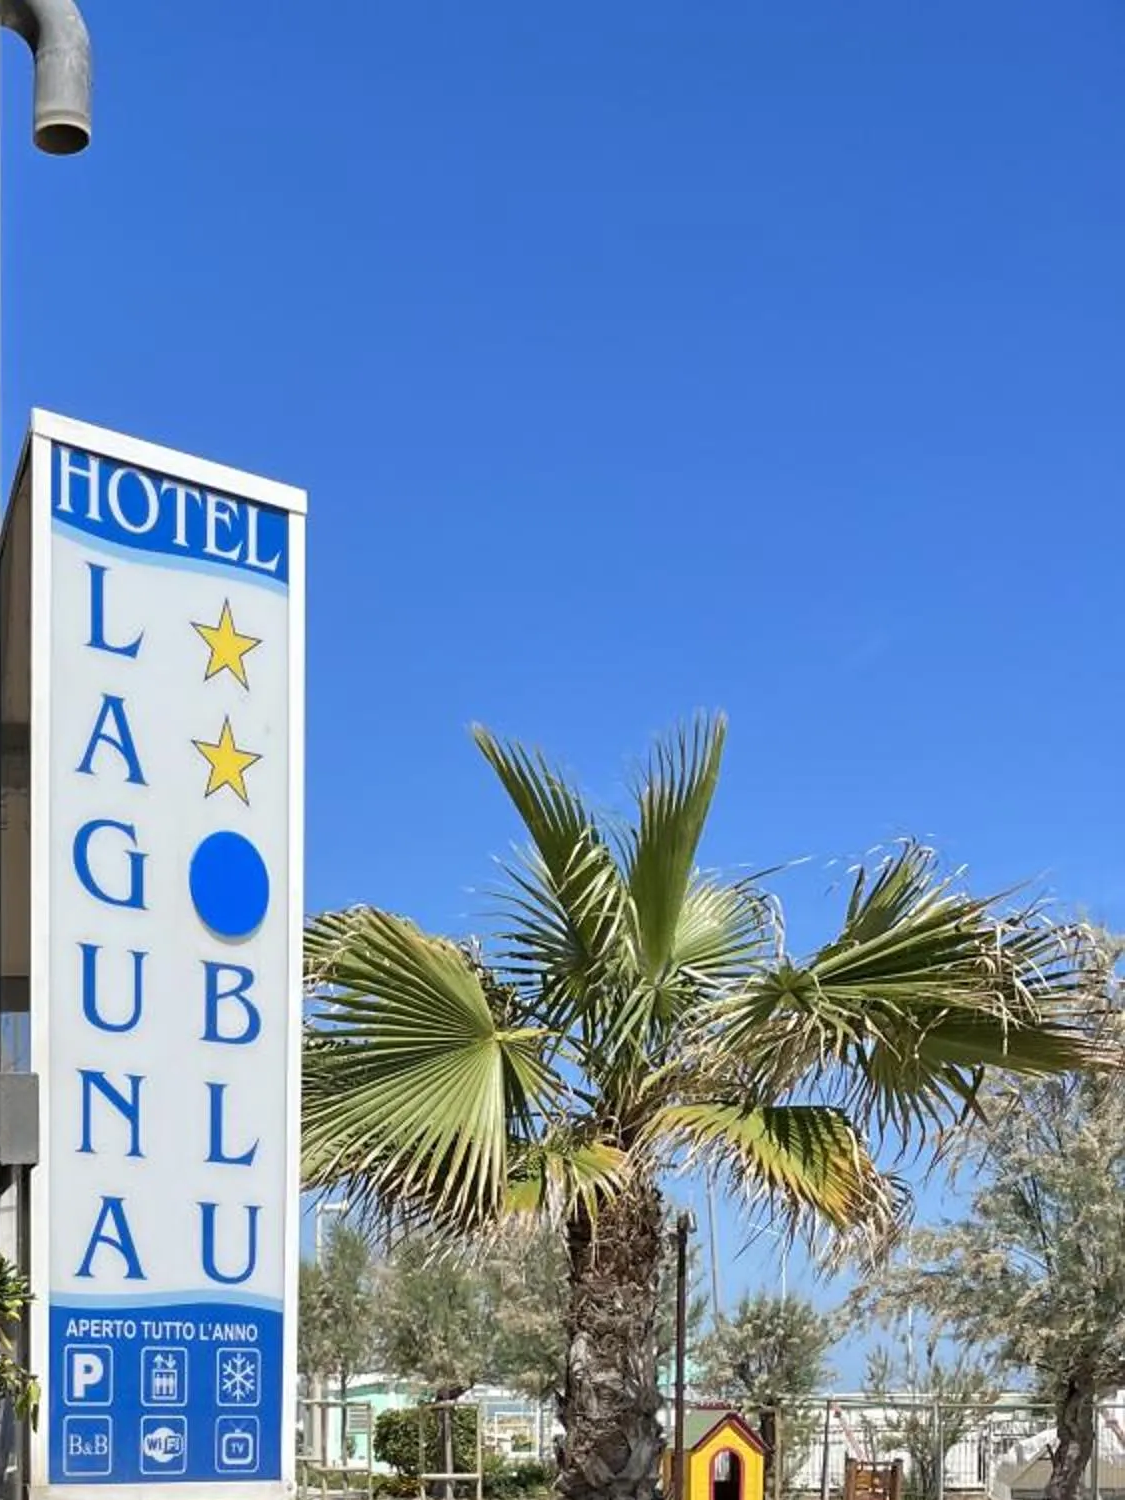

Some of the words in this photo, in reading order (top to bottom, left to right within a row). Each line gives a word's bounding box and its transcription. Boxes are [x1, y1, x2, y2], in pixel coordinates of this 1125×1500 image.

[57, 447, 282, 573] HOTEL
[72, 562, 149, 1281] LAGUNA
[195, 959, 264, 1285] BLU
[66, 1319, 137, 1339] APERTO
[141, 1321, 195, 1341] TUTTO
[199, 1323, 258, 1342] L'ANNO
[73, 1353, 104, 1398] P
[68, 1434, 108, 1456] B&B
[230, 1442, 245, 1454] TV
